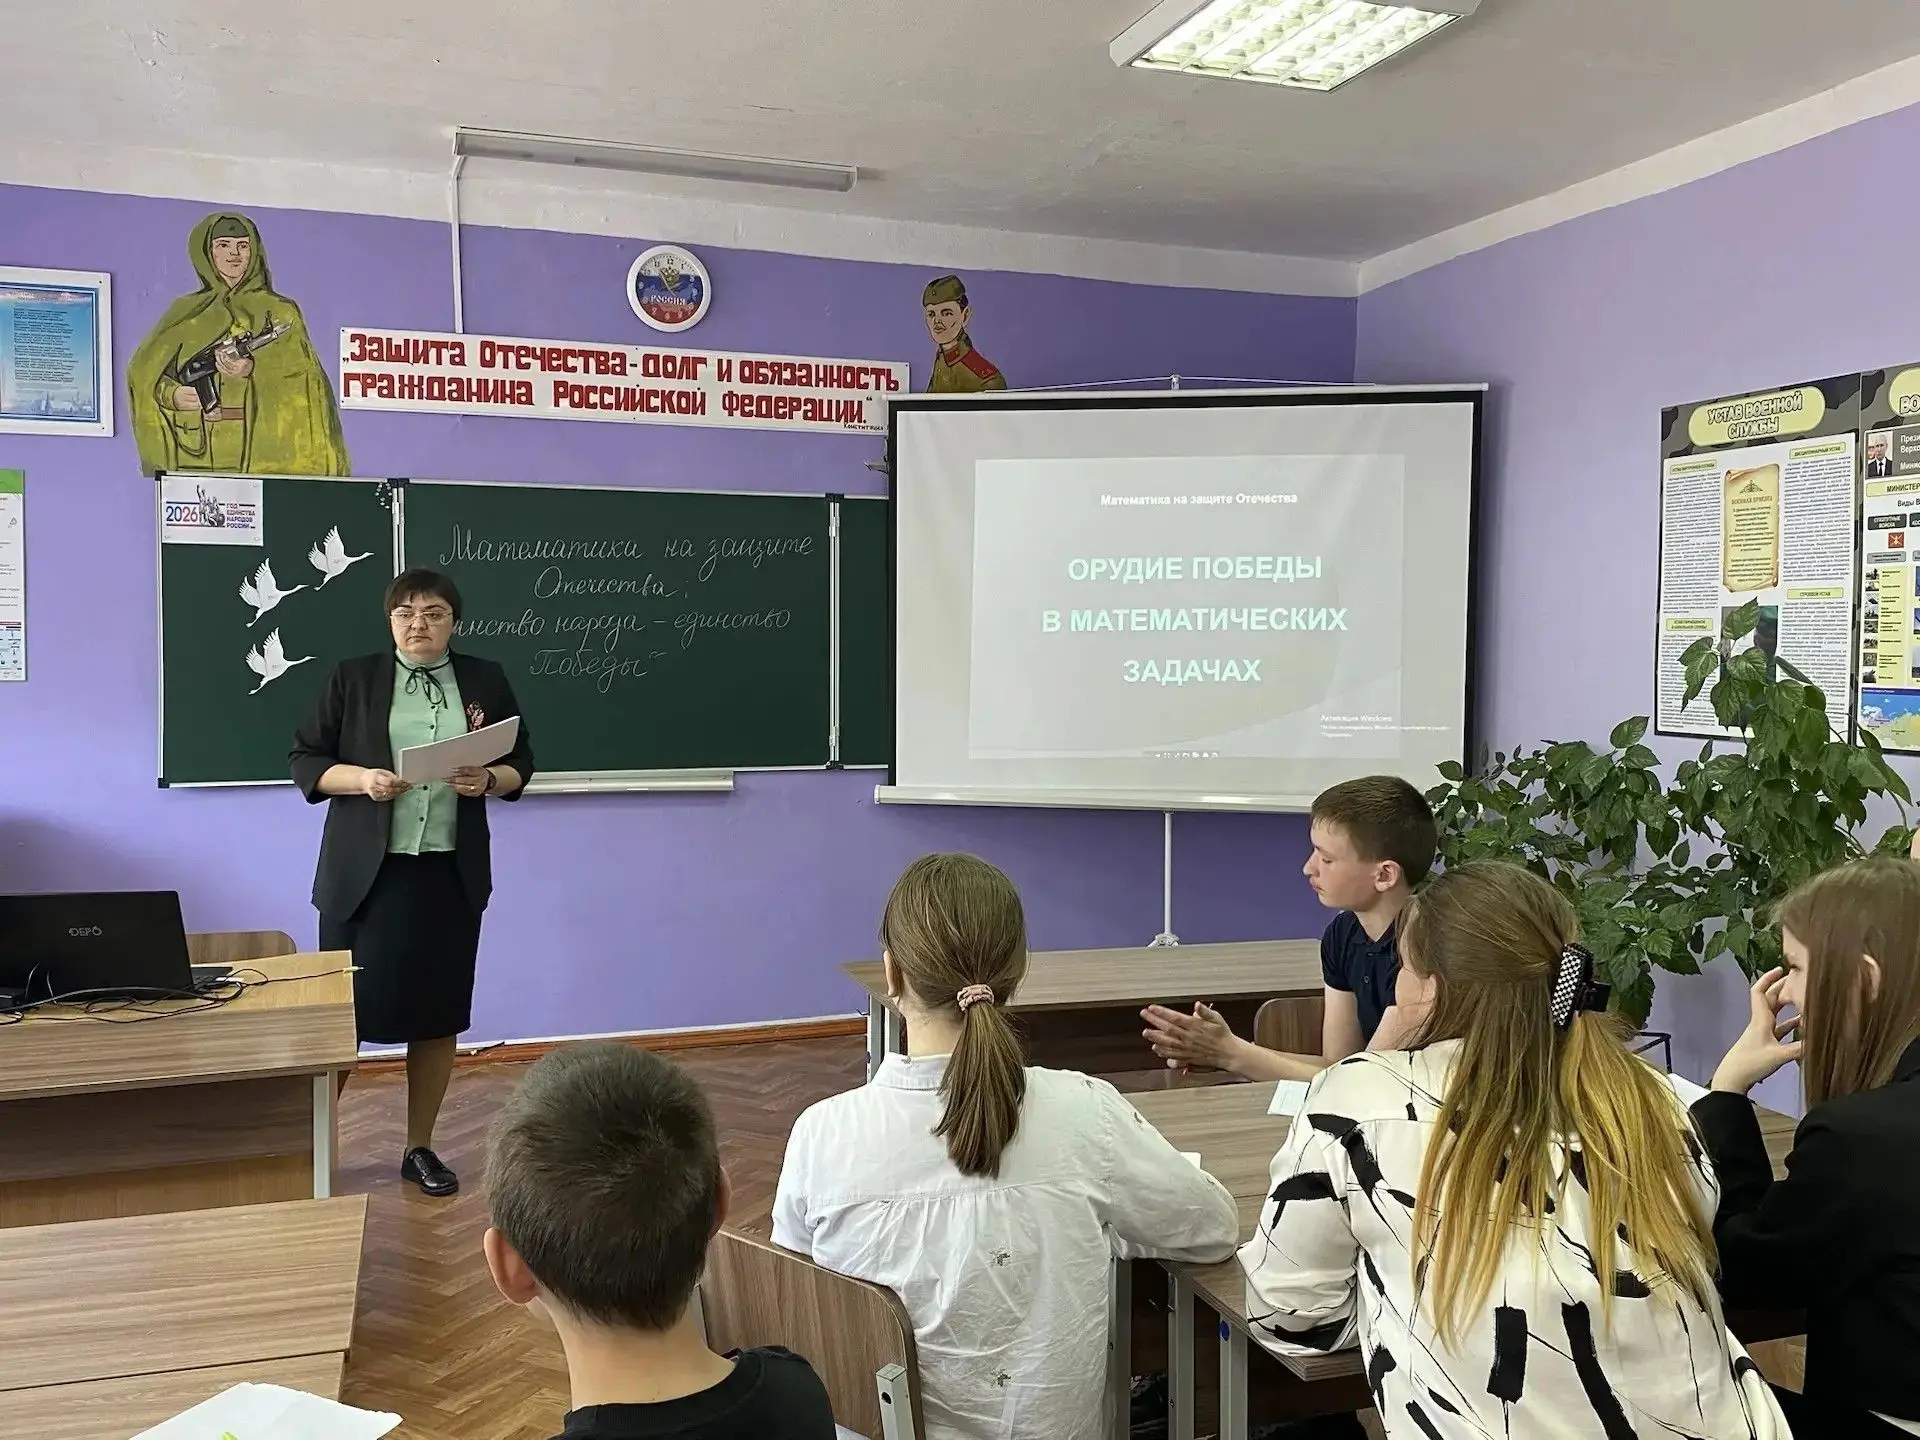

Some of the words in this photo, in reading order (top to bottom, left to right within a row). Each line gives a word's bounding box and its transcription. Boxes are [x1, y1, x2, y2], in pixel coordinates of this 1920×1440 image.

[650, 294, 686, 306] РОССИЯ
[716, 358, 732, 383] и
[738, 359, 900, 392] обязанность
[343, 372, 535, 406] гражданина
[553, 379, 706, 416] Российской
[1707, 404, 1744, 425] УСТАВ
[1744, 390, 1803, 419] ВОЕННОЙ
[1728, 416, 1780, 440] СЛУЖБЫ
[1100, 494, 1171, 506] Математика
[1173, 496, 1187, 505] на
[1189, 495, 1233, 506] защите
[1235, 492, 1298, 504] Отечества
[165, 505, 198, 522] 2026
[664, 538, 696, 558] на
[698, 536, 814, 583] защите
[1067, 556, 1183, 584] ОРУДИЕ
[1192, 555, 1322, 583] ПОБЕДЫ
[554, 613, 646, 653] народа
[672, 608, 792, 650] единство
[1042, 610, 1062, 632] В
[1070, 606, 1348, 632] МАТЕМАТИЧЕСКИХ
[1123, 659, 1261, 686] ЗАДАЧАХ
